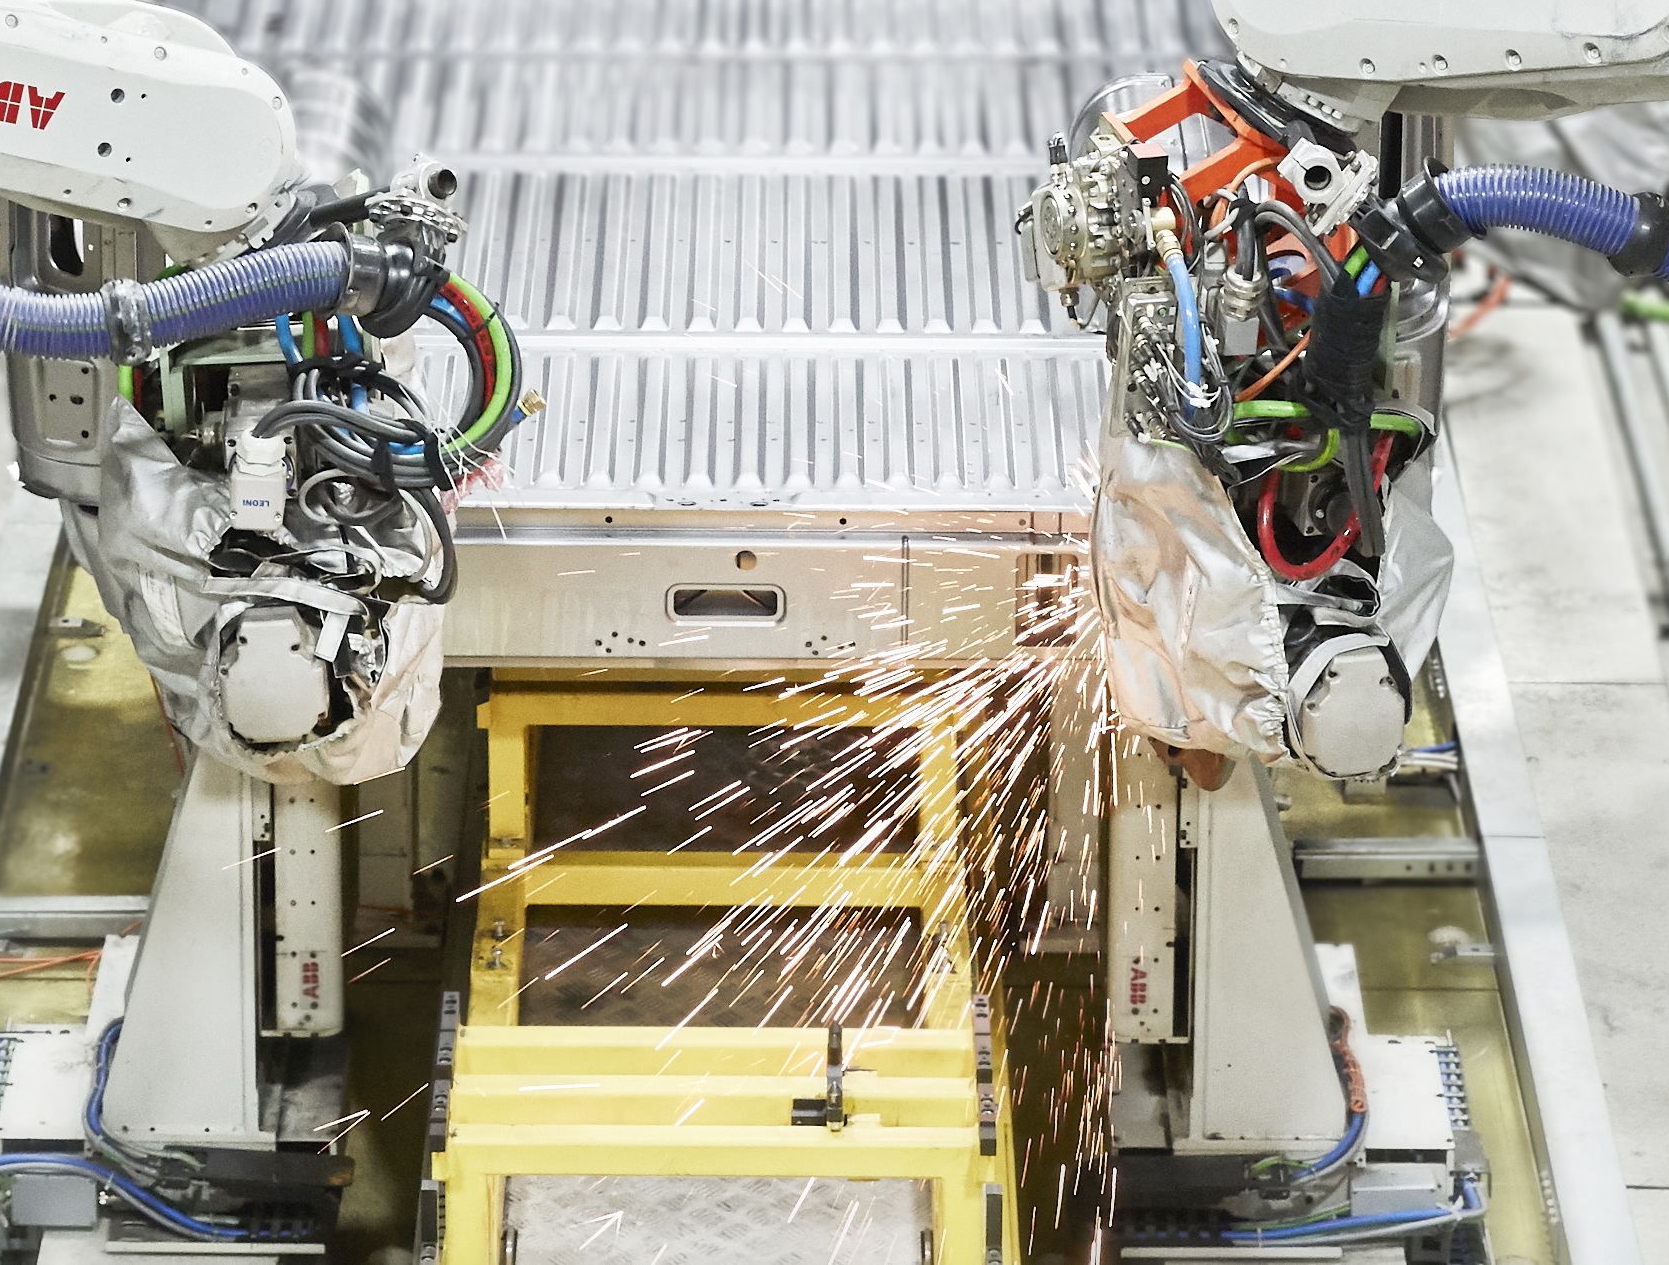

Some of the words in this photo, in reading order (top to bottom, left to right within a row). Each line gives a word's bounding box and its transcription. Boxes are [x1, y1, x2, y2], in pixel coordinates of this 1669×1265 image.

[242, 499, 270, 507] LEONI
[302, 961, 319, 999] ABB
[1130, 967, 1147, 1005] ABB
